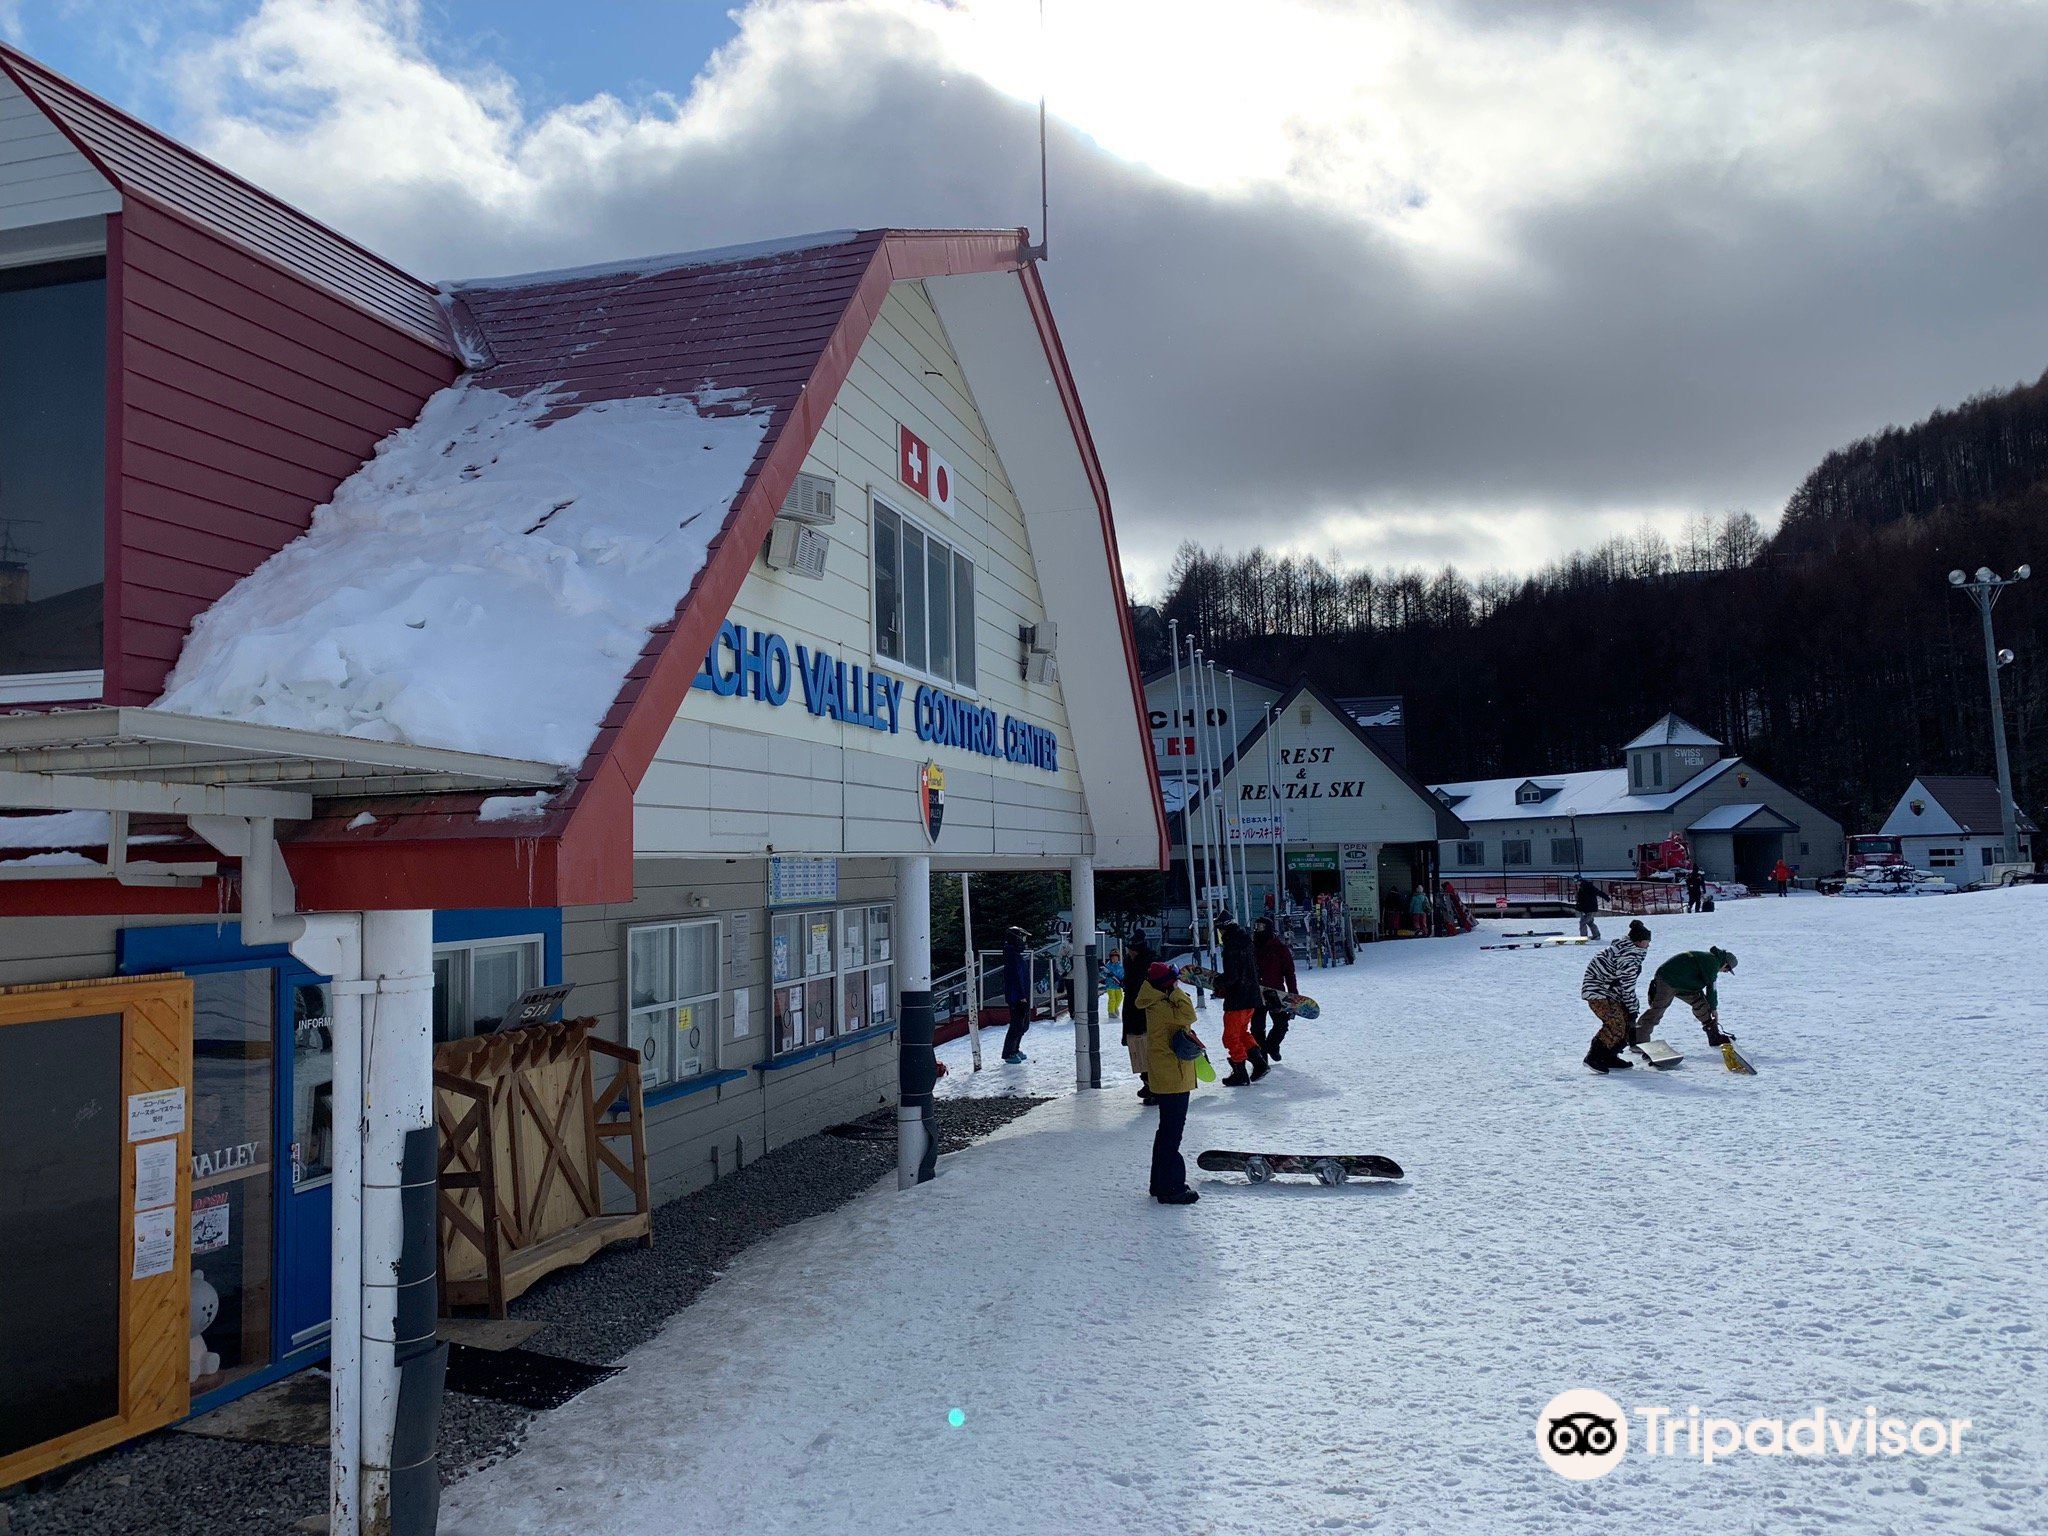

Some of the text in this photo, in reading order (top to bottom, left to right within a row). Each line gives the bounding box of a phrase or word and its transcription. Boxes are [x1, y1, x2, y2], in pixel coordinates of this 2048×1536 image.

[797, 645, 904, 733] VALLEY
[915, 685, 1003, 758] CONTROL
[1004, 715, 1058, 772] CENTER
[1277, 747, 1335, 765] REST
[1675, 748, 1701, 757] SWISS
[1685, 757, 1704, 766] HEIM
[1296, 768, 1307, 779] &
[1241, 781, 1366, 801] RENTAL SKI
[1344, 843, 1368, 851] OPEN
[519, 1003, 551, 1019] SIA
[192, 1142, 259, 1180] VALLEY
